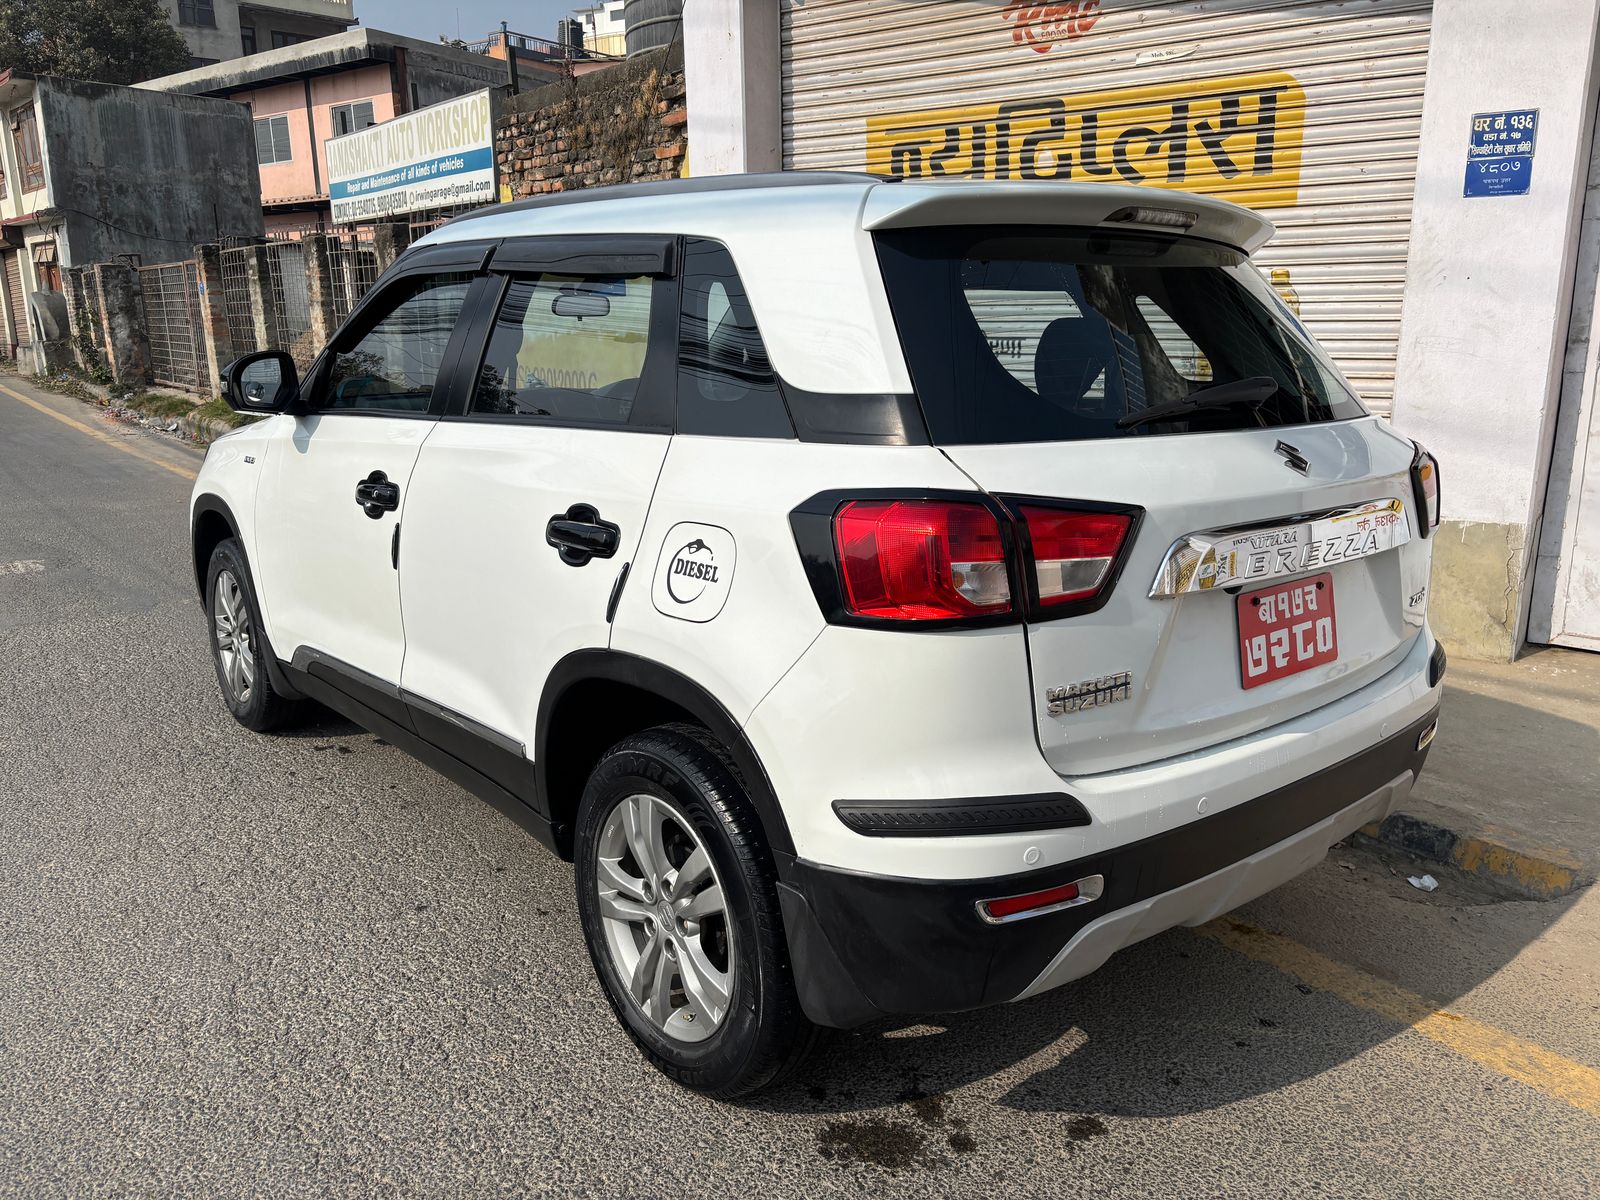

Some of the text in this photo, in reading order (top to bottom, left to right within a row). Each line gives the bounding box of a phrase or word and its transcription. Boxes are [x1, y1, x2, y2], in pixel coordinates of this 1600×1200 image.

[387, 122, 415, 166] AUTO
[416, 95, 490, 156] WORKSHOP
[1474, 117, 1492, 131] घर
[1511, 114, 1533, 130] १३६
[347, 181, 360, 194] Repair
[361, 178, 370, 190] and
[370, 172, 400, 188] Maintenance
[400, 170, 407, 181] of
[416, 163, 430, 177] kinds
[431, 161, 437, 174] of
[439, 156, 464, 172] vehicles
[1244, 528, 1380, 579] BREZZA
[1250, 530, 1298, 550] VITARA
[674, 557, 719, 583] DIESEL
[1245, 616, 1333, 677] ७२८०
[1046, 670, 1132, 702] MARUTI
[1046, 685, 1132, 718] SUZUKI
